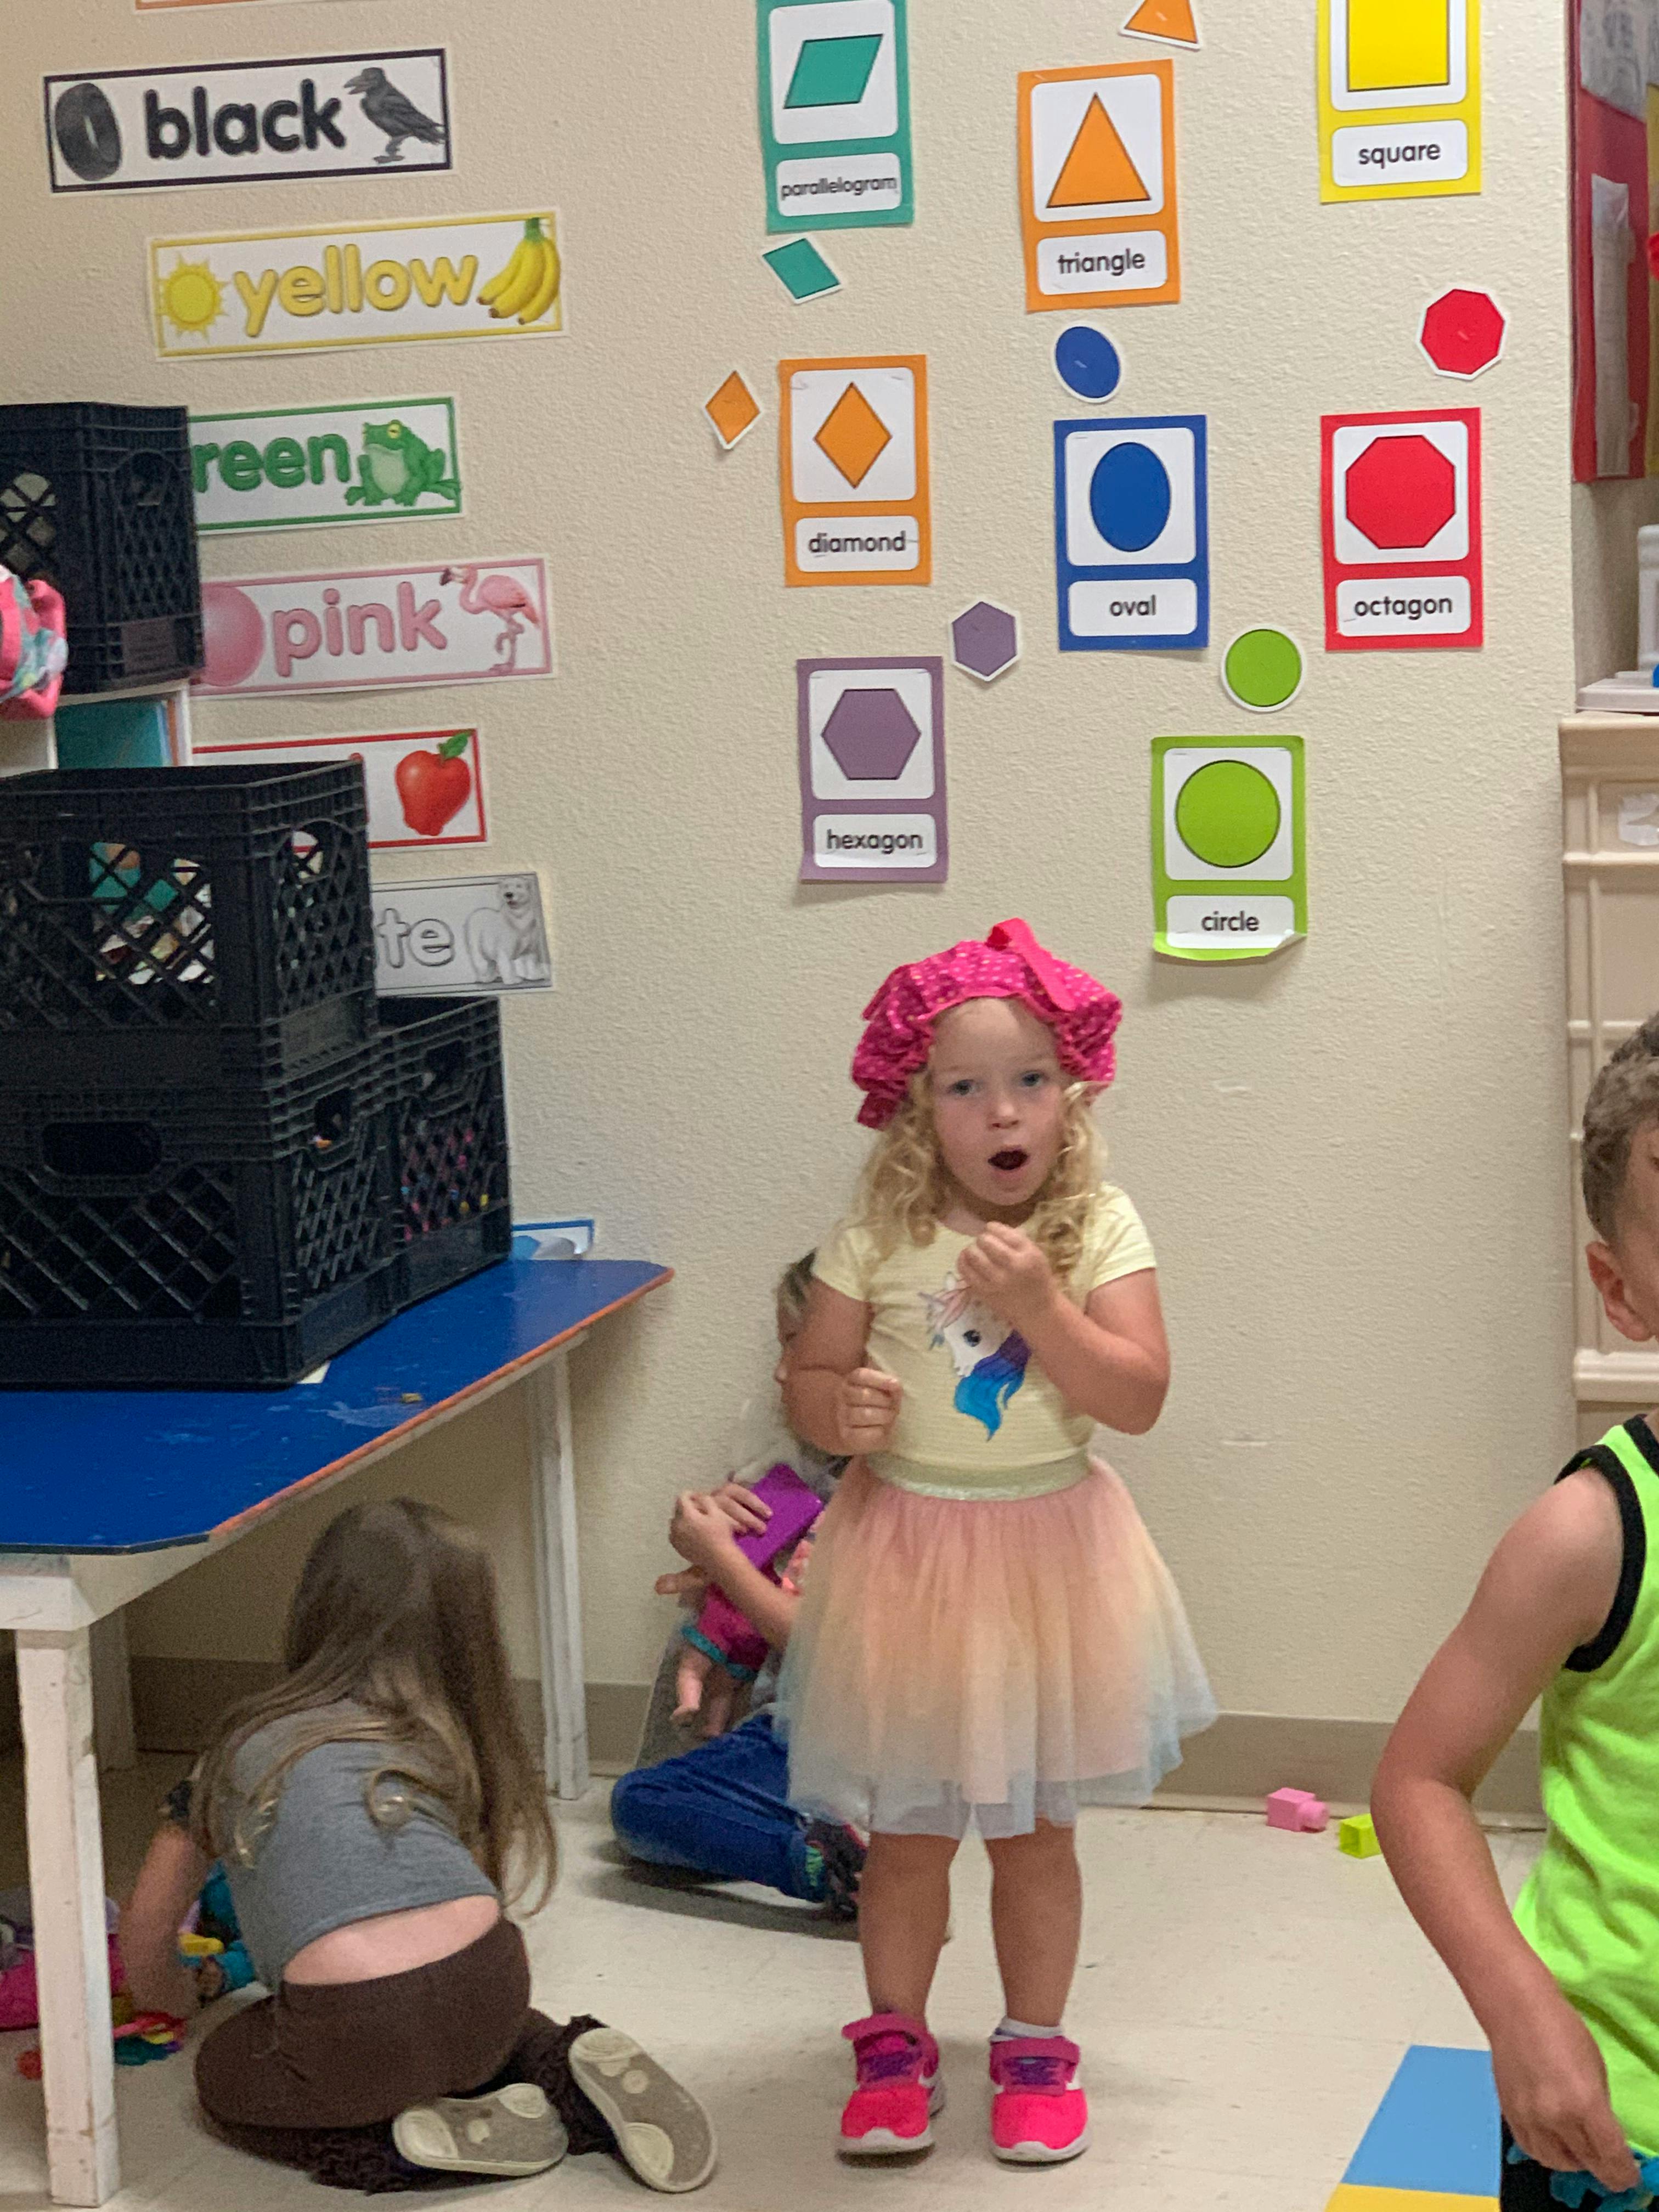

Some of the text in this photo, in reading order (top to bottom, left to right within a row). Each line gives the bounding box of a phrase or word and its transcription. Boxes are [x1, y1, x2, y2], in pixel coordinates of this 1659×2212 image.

[145, 78, 346, 160] black
[1358, 143, 1442, 170] square
[781, 177, 898, 201] parallelogram
[1057, 247, 1147, 276] triangle
[234, 243, 479, 338] yellow
[193, 433, 350, 493] reen
[808, 530, 906, 553] diamond
[1109, 594, 1156, 617] oval
[1353, 596, 1453, 620] octagon
[272, 581, 448, 677] pink
[826, 828, 923, 854] hexagon
[1201, 910, 1260, 932] circle
